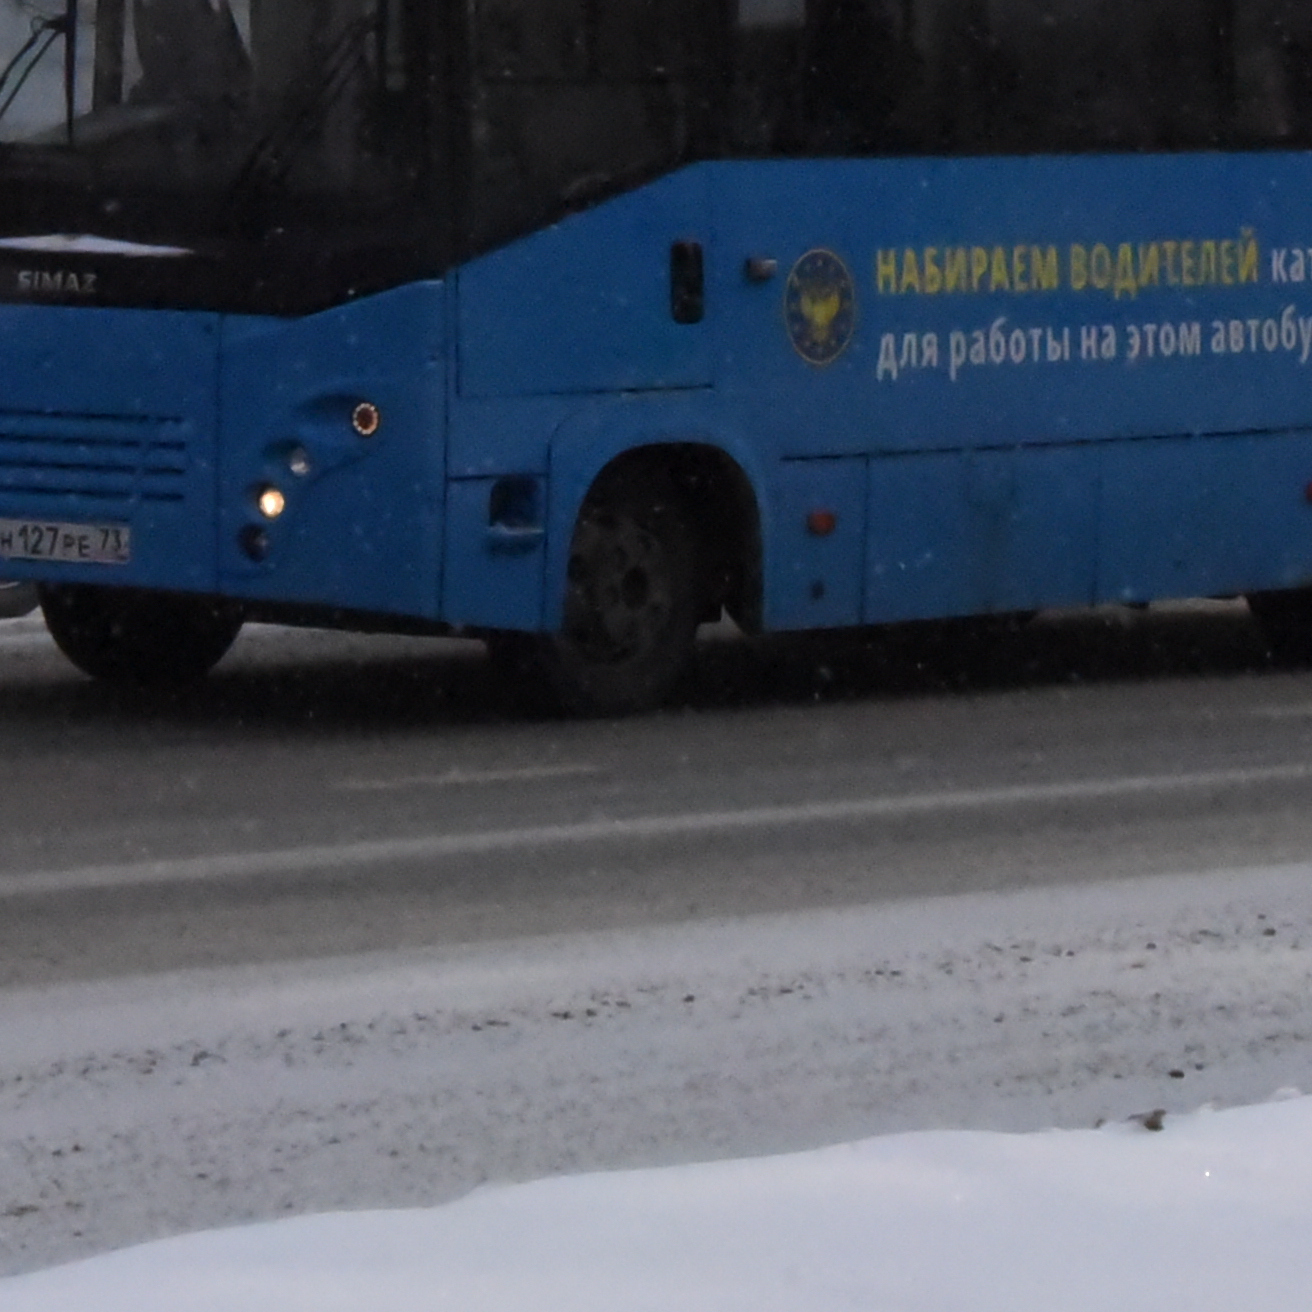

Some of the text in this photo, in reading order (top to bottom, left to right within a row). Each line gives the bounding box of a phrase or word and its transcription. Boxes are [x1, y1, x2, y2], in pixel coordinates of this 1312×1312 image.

[18, 268, 98, 293] SIMAZ
[876, 245, 1060, 295] НАБИРАЕМ
[1069, 226, 1260, 301] ВОДИТЕЛЕЙ
[876, 331, 939, 381] для
[949, 315, 1071, 382] работы
[1083, 323, 1118, 361] на
[1126, 320, 1202, 363] этом
